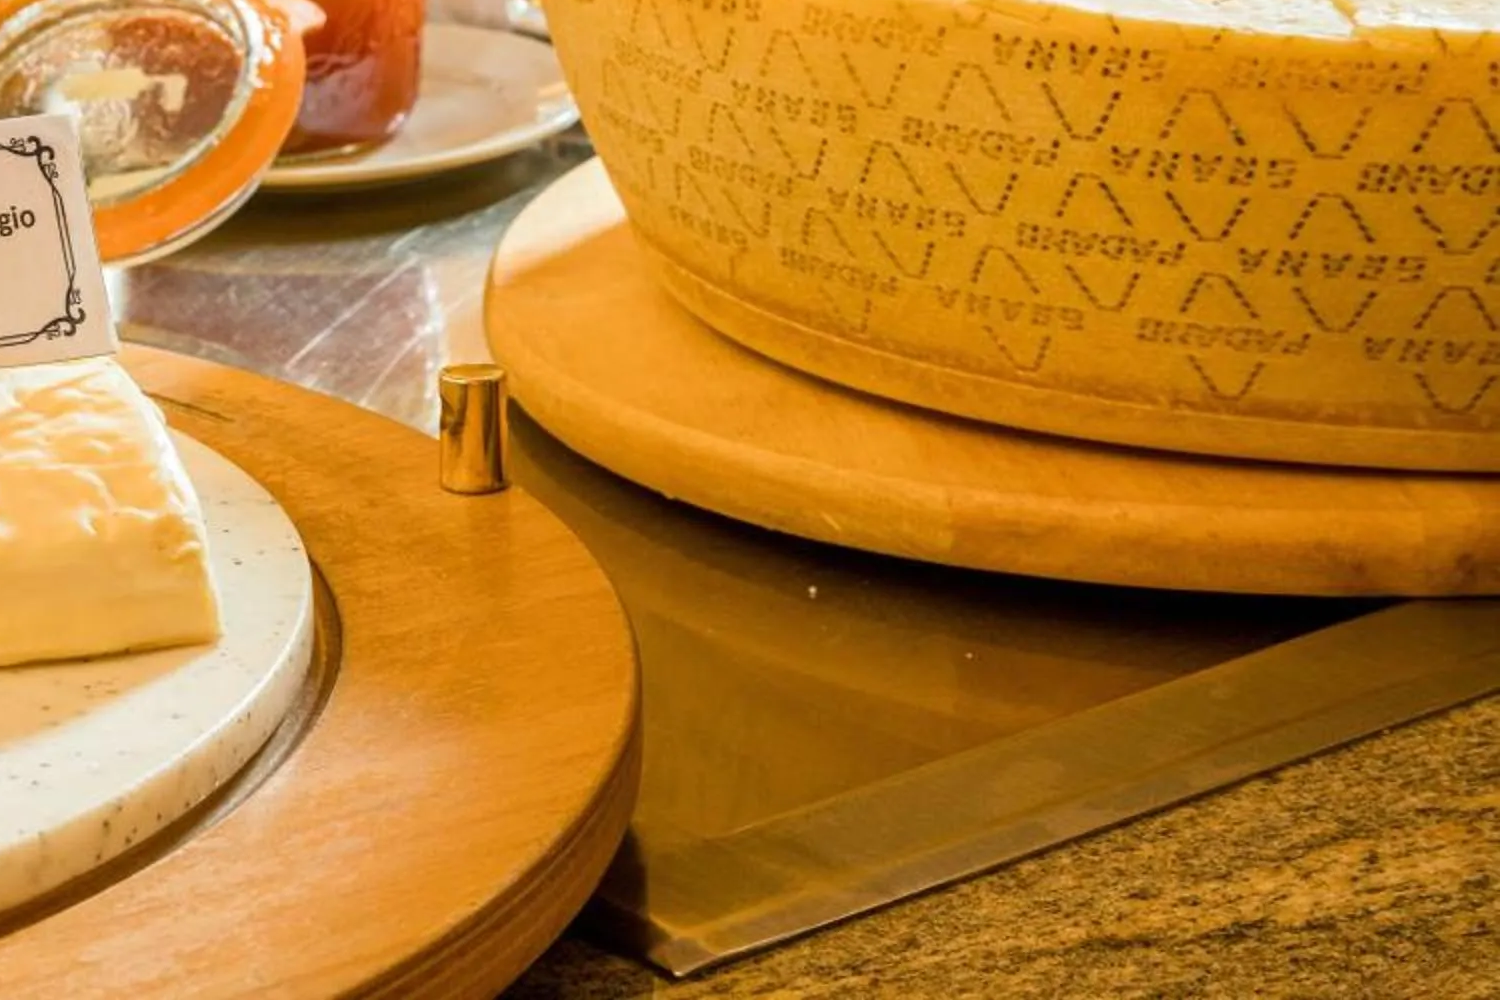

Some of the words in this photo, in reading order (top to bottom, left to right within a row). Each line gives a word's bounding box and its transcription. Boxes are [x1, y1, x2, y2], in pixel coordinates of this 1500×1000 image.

[992, 33, 1168, 82] GRANA
[730, 80, 858, 136] GRANA
[900, 116, 1061, 169] PADANO
[1110, 145, 1297, 190] GRANA
[1356, 162, 1500, 197] DANO
[827, 188, 966, 239] GRANA
[1016, 223, 1186, 267] PADANO
[1238, 247, 1429, 283] GRANA
[934, 285, 1085, 332] GRANA
